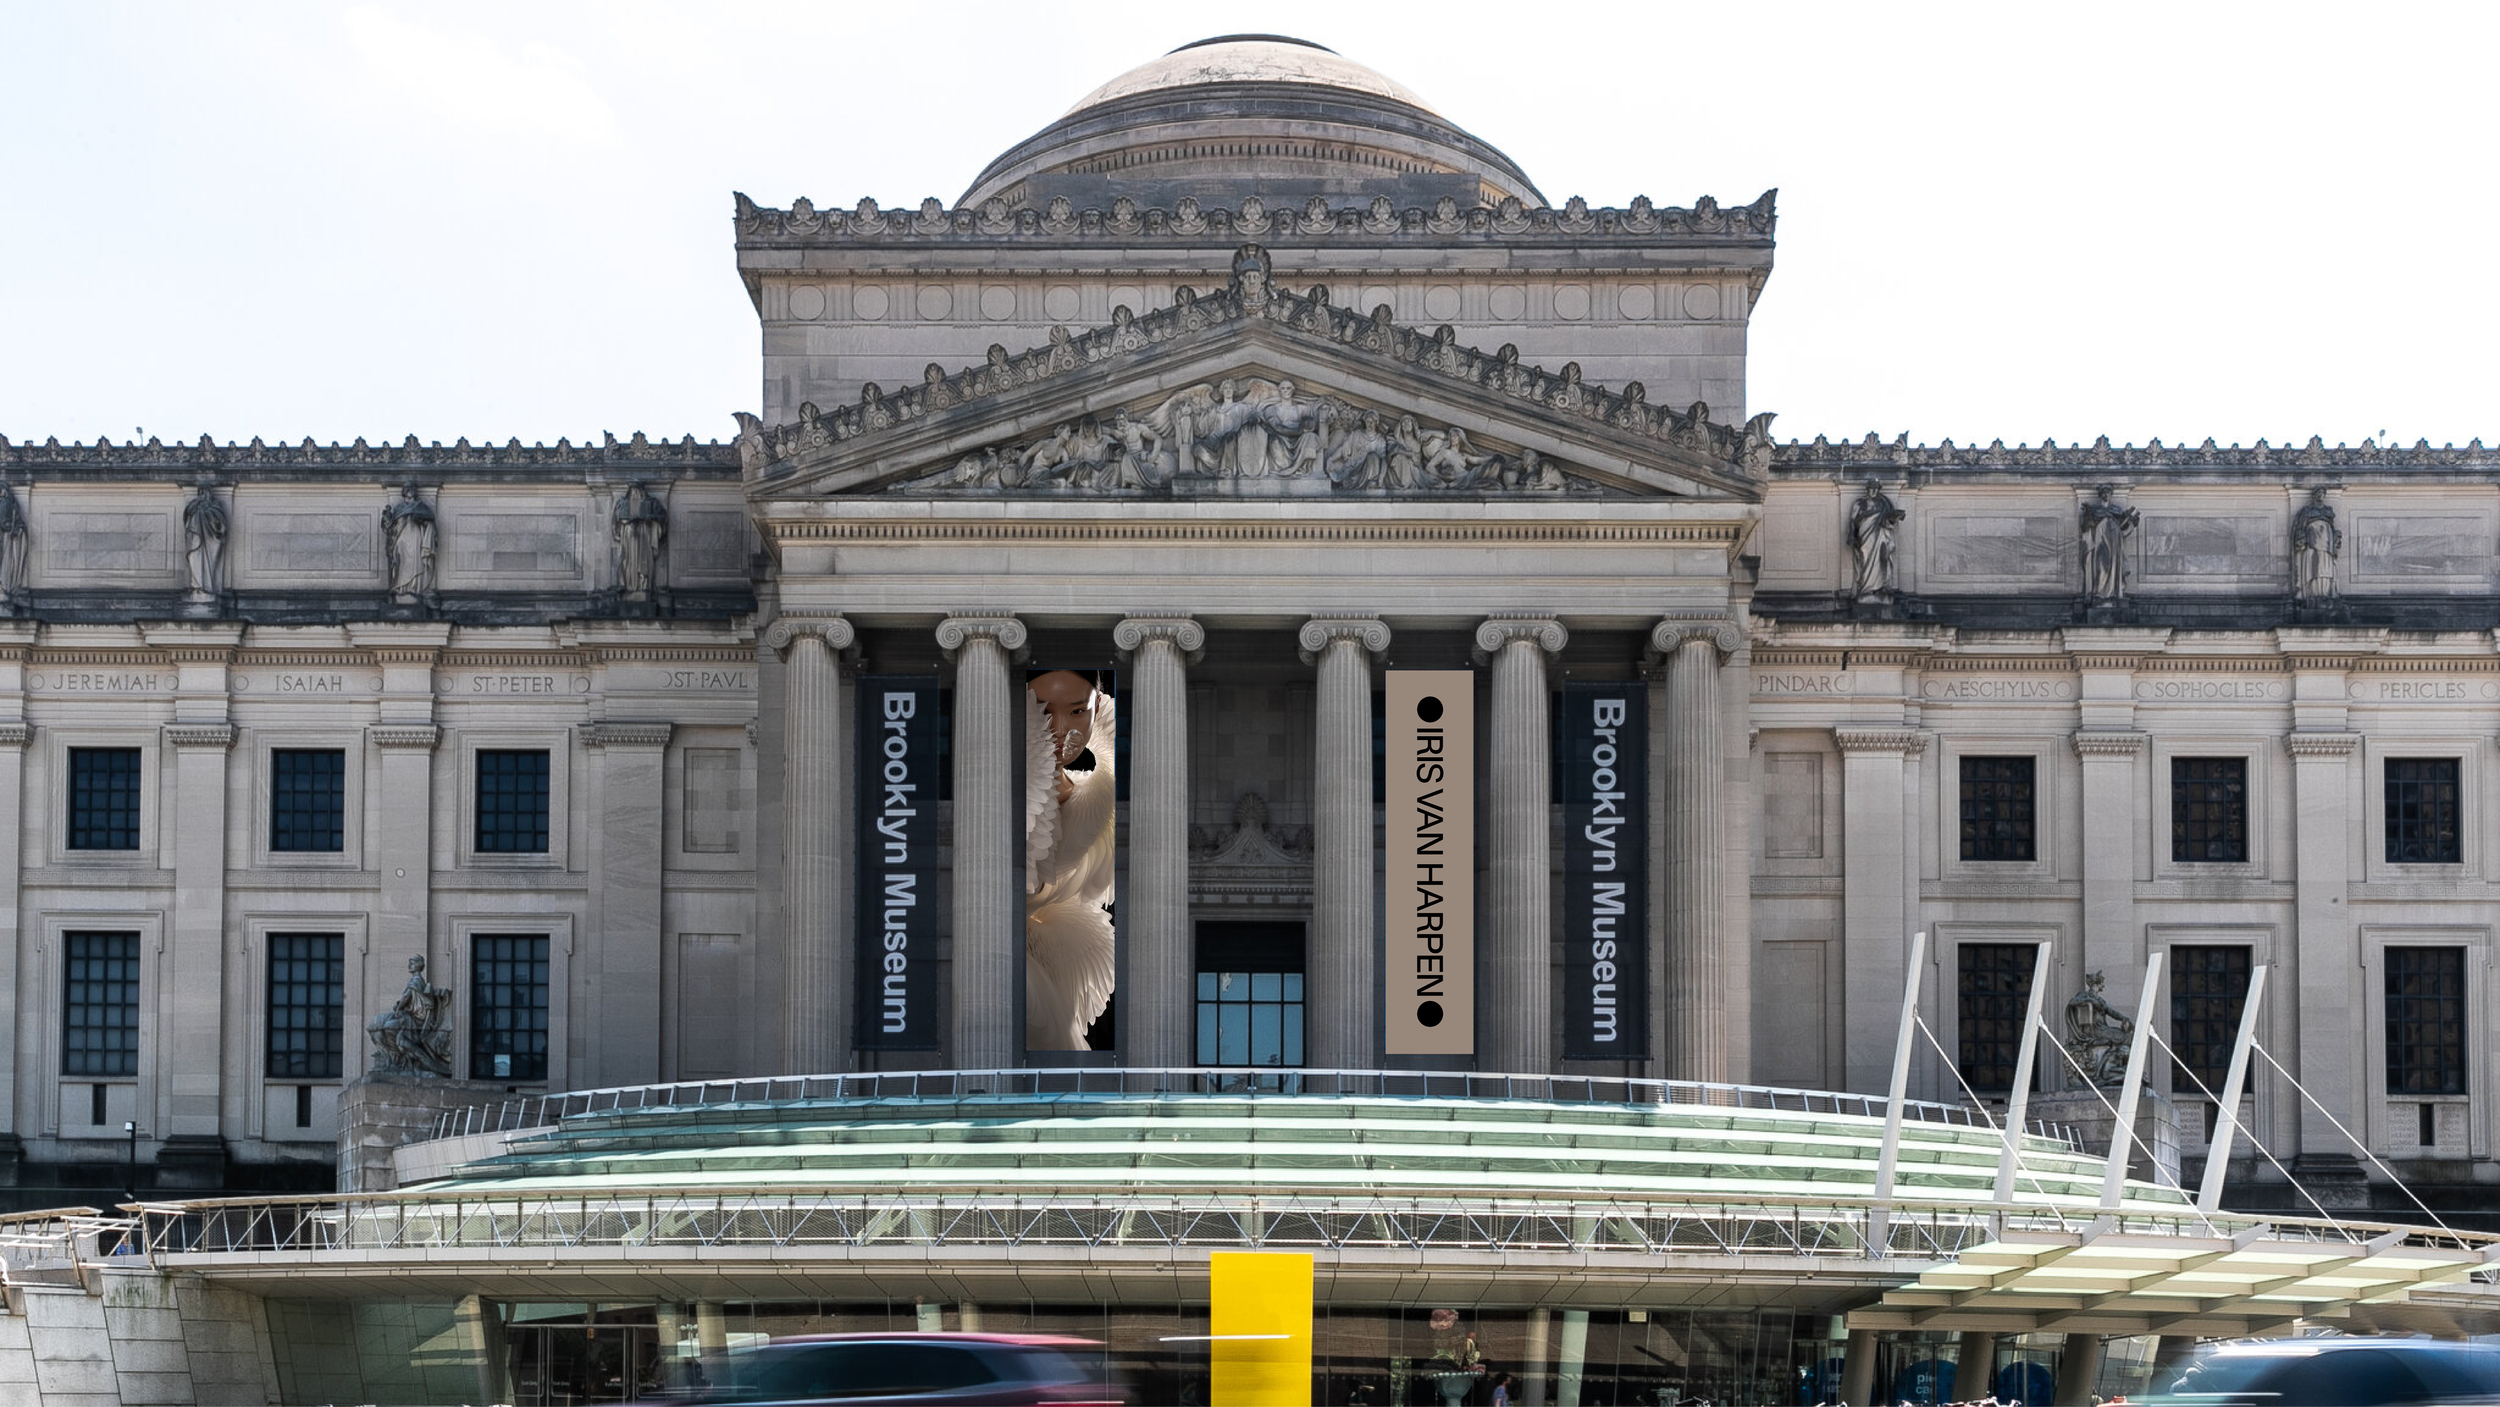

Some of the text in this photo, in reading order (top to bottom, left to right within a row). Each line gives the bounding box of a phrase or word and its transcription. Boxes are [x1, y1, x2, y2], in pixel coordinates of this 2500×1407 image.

[53, 674, 157, 690] JEREMIAH
[275, 675, 342, 691] ISAIAH
[1759, 675, 1832, 692] PINDAR
[1944, 681, 2050, 697] AESCHYLVS
[2154, 682, 2264, 698] SOPHOCLES
[2380, 682, 2466, 699] PERICLES
[877, 692, 917, 1033] Brooklyn Museum
[1416, 727, 1444, 997] IRIS VAN HARPEN
[1585, 699, 1626, 1042] Brooklyn Museum
